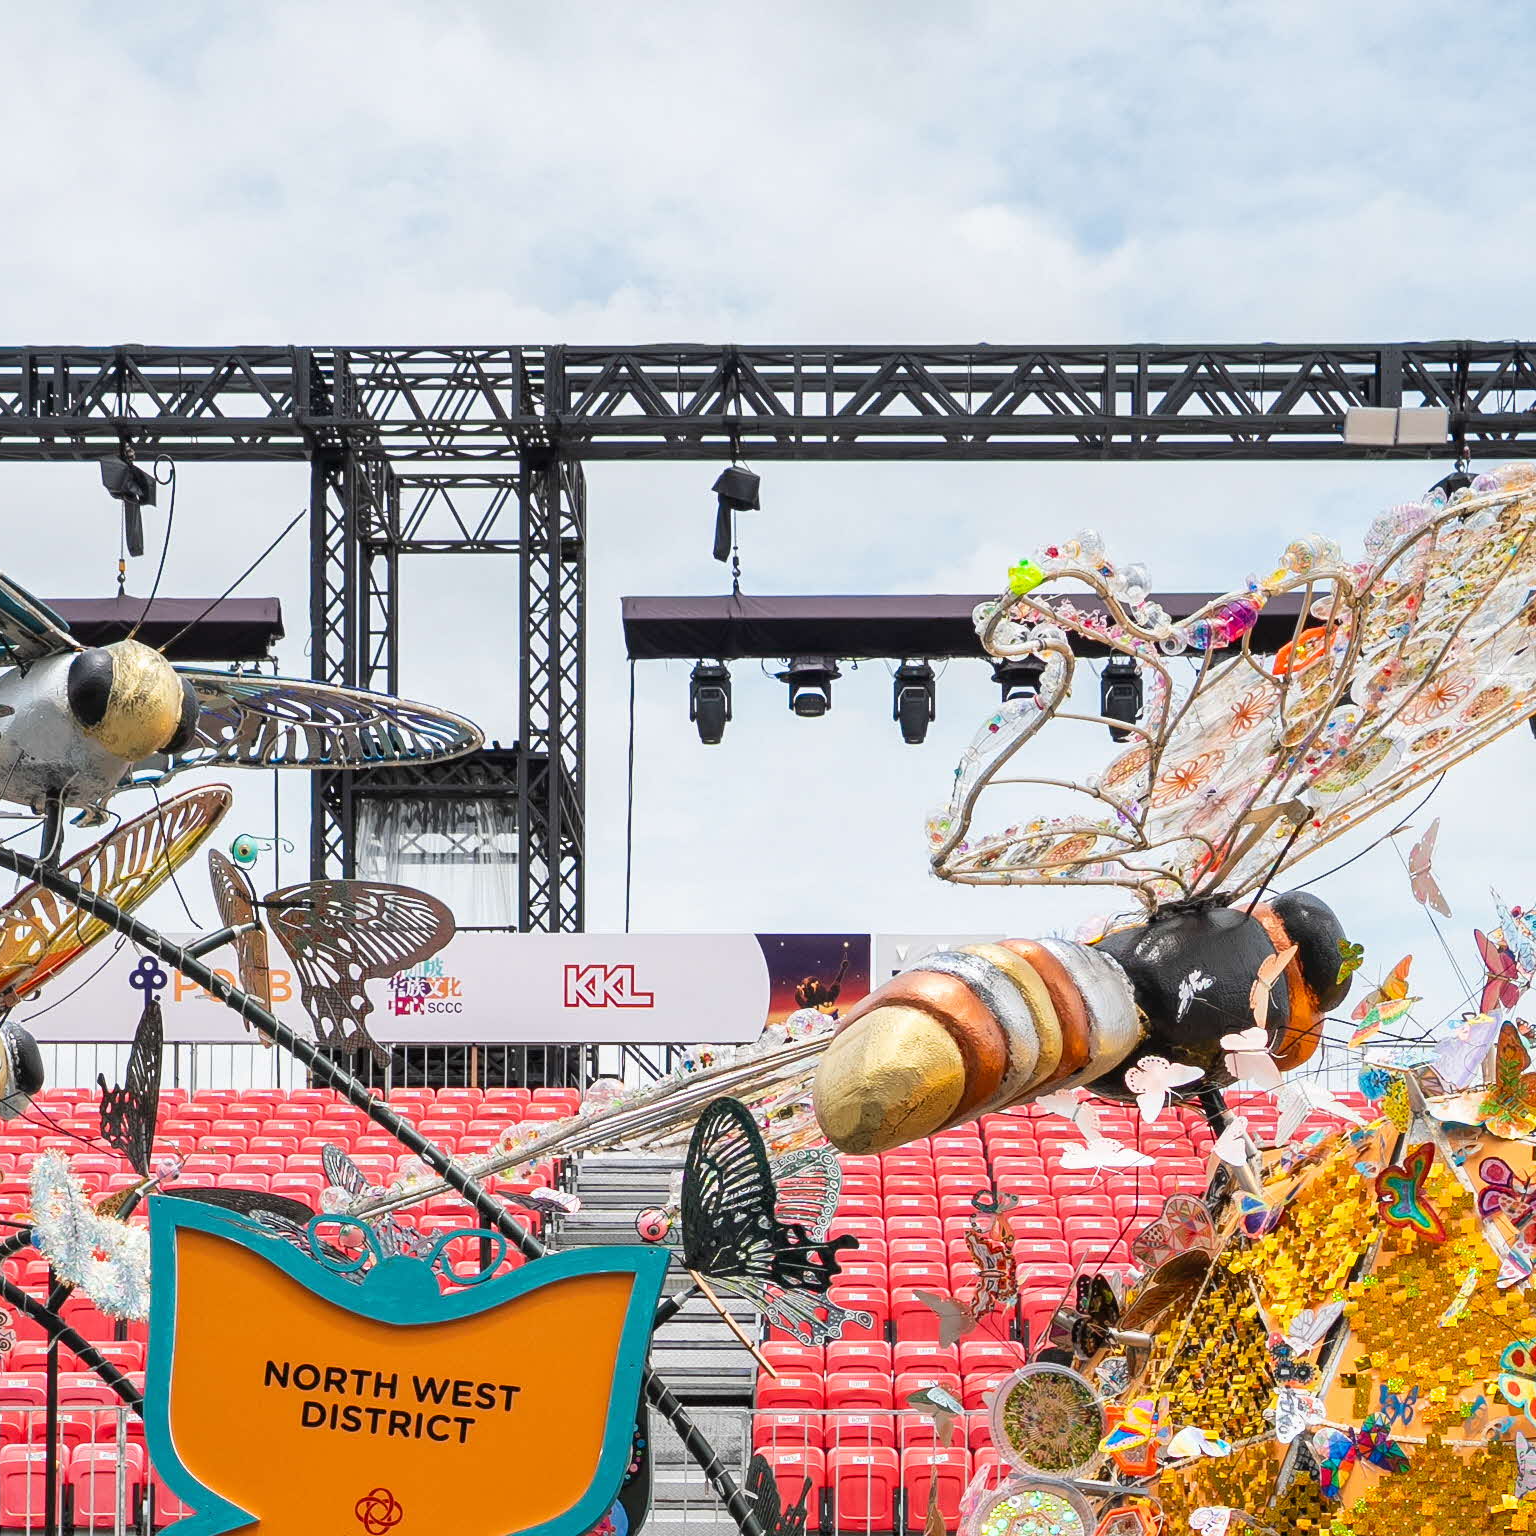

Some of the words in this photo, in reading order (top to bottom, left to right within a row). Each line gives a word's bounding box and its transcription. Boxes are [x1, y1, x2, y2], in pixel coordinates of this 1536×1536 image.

[427, 1002, 463, 1014] SCCC
[564, 964, 654, 1008] KKL
[264, 1360, 398, 1400] NORTH
[411, 1376, 521, 1413] WEST
[300, 1401, 476, 1445] DISTRICT
